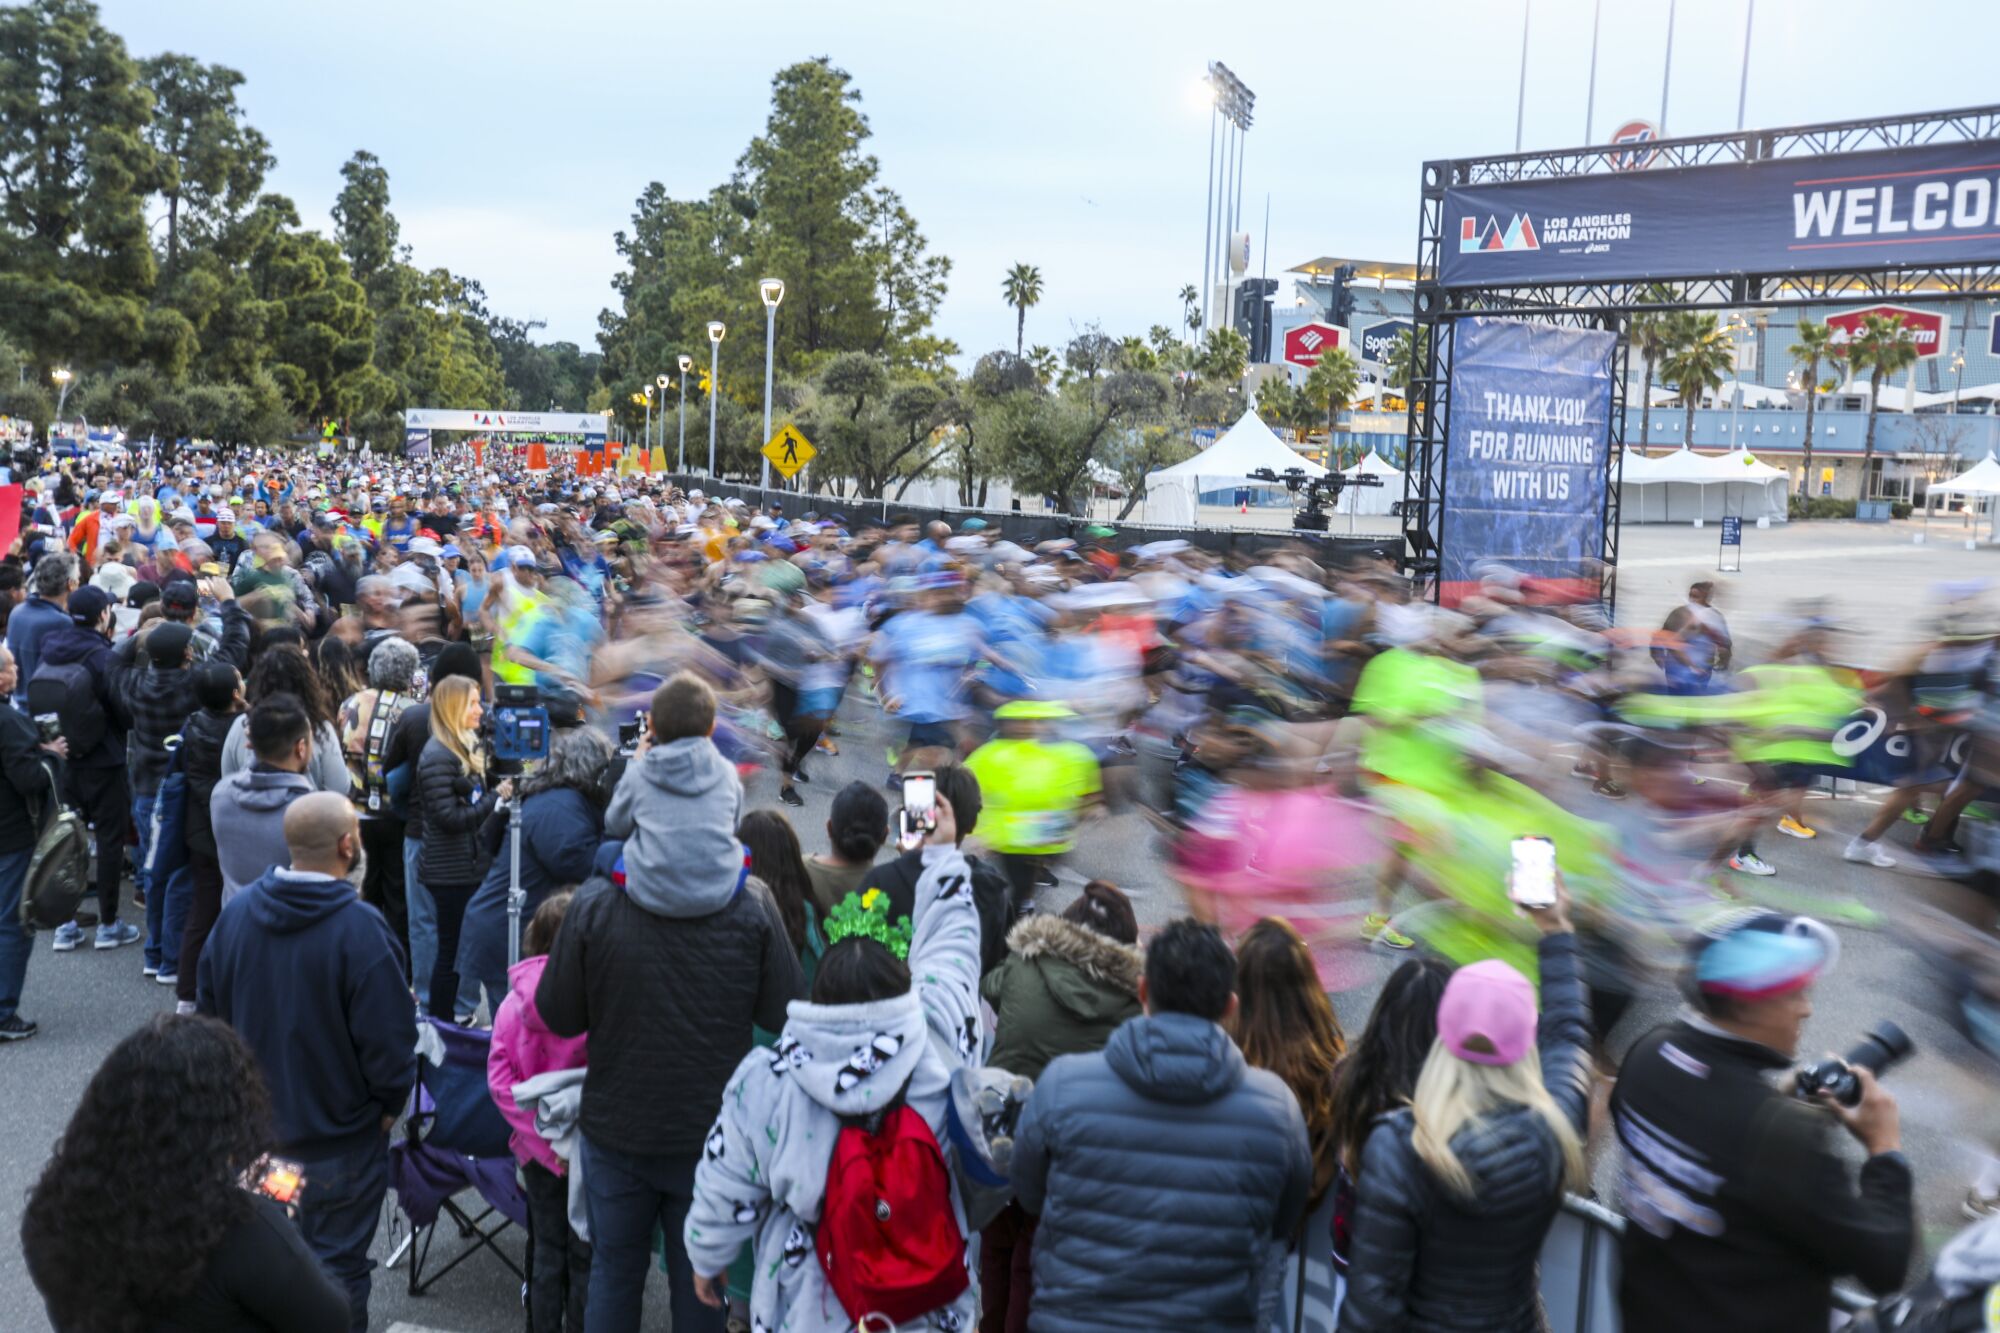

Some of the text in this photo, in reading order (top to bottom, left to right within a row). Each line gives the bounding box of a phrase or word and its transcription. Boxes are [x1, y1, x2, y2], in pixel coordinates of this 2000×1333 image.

[1544, 213, 1632, 230] LOS ANGELES
[1793, 177, 2000, 239] WELCO
[1543, 226, 1631, 243] MARATHON
[1484, 391, 1586, 426] THANK YOU
[1468, 430, 1593, 464] FOR RUNNING
[1493, 470, 1570, 500] WITH US
